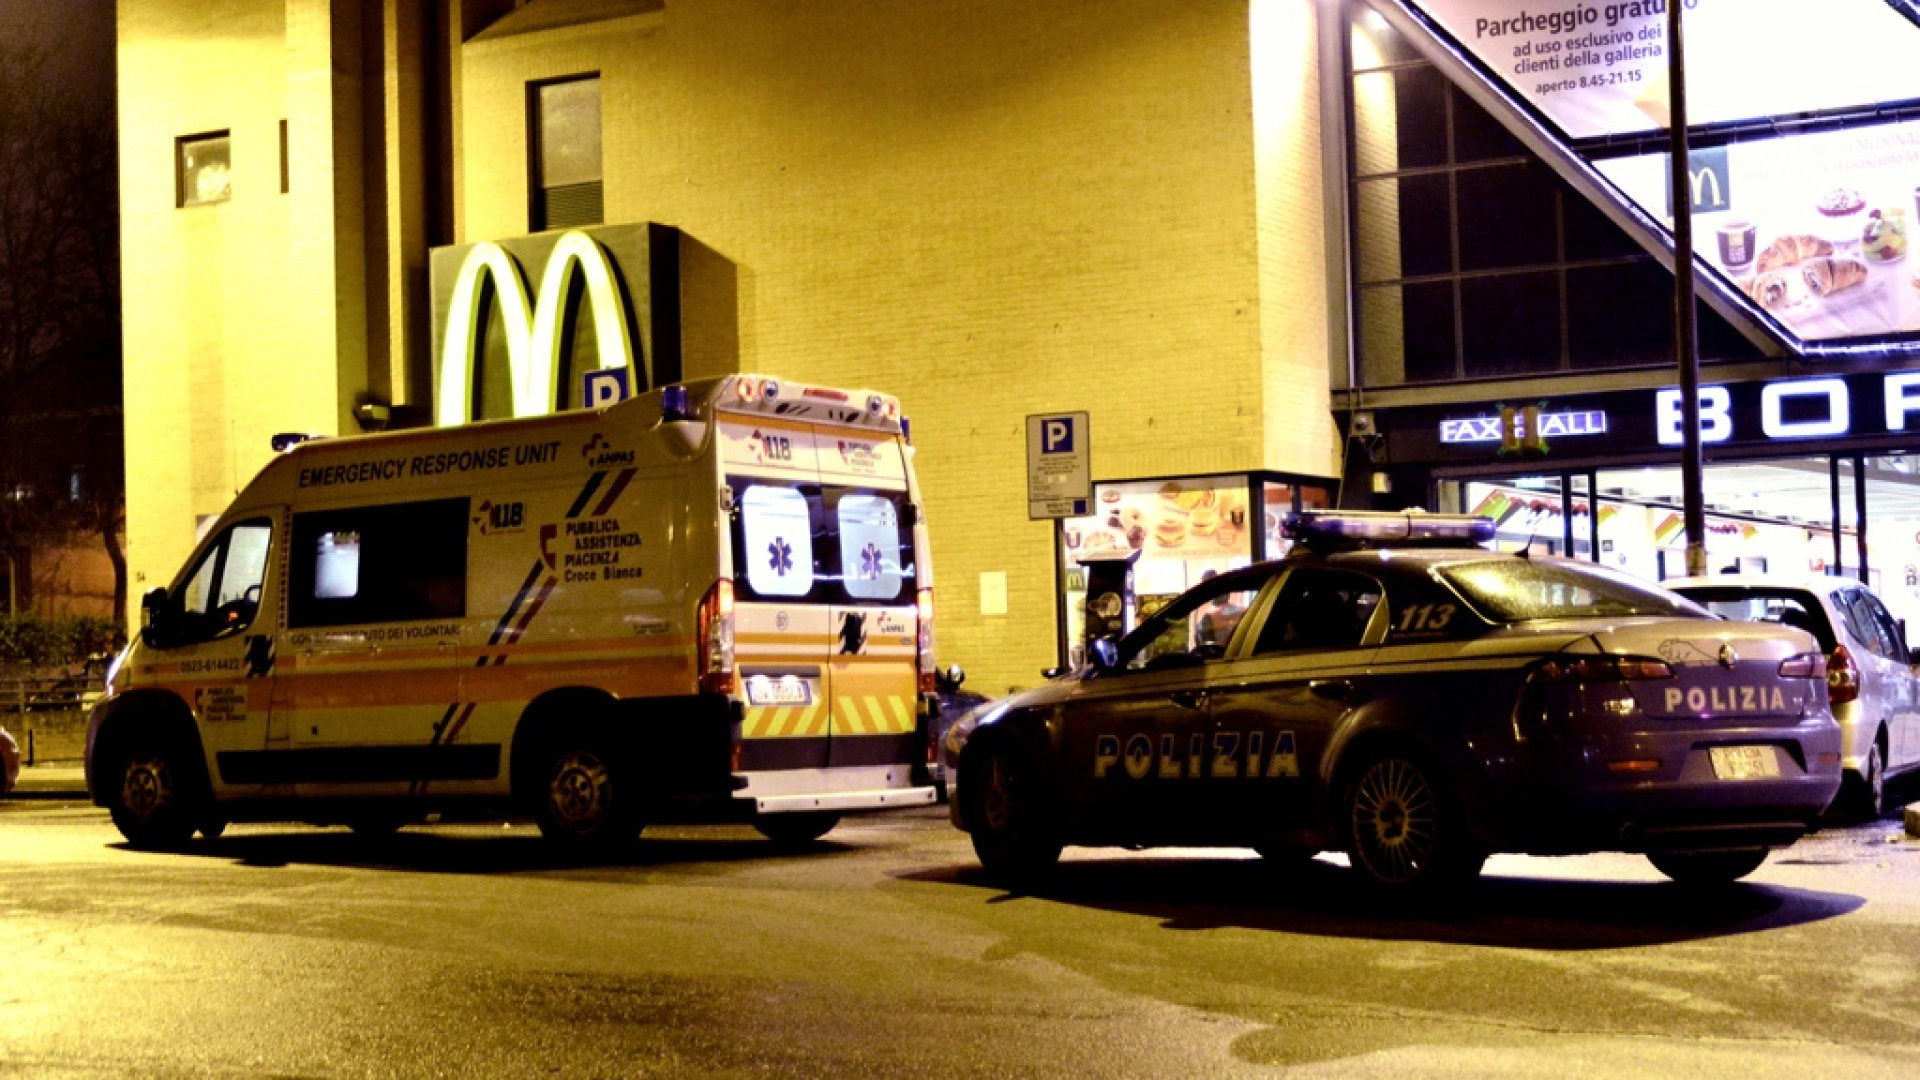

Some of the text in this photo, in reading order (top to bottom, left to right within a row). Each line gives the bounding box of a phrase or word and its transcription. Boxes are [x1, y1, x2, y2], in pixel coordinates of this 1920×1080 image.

[1476, 4, 1598, 39] Parcheggio
[1513, 24, 1662, 57] ad uso esclusivo dei
[1514, 43, 1662, 74] clienti della galleria
[1535, 70, 1642, 95] aperto 8.45-21.15
[766, 434, 792, 461] 118
[1047, 421, 1069, 451] P
[299, 441, 562, 488] EMERGENCY RESPONSE UNIT
[494, 502, 524, 527] 118
[566, 519, 619, 536] PUBBLICA
[575, 532, 642, 550] ASSISTENZA
[564, 550, 619, 567] PIACENZA
[564, 566, 642, 583] Croce Bianca
[1398, 602, 1456, 631] 113
[1665, 685, 1786, 713] POLIZIA
[1094, 730, 1300, 778] POLIZIA
